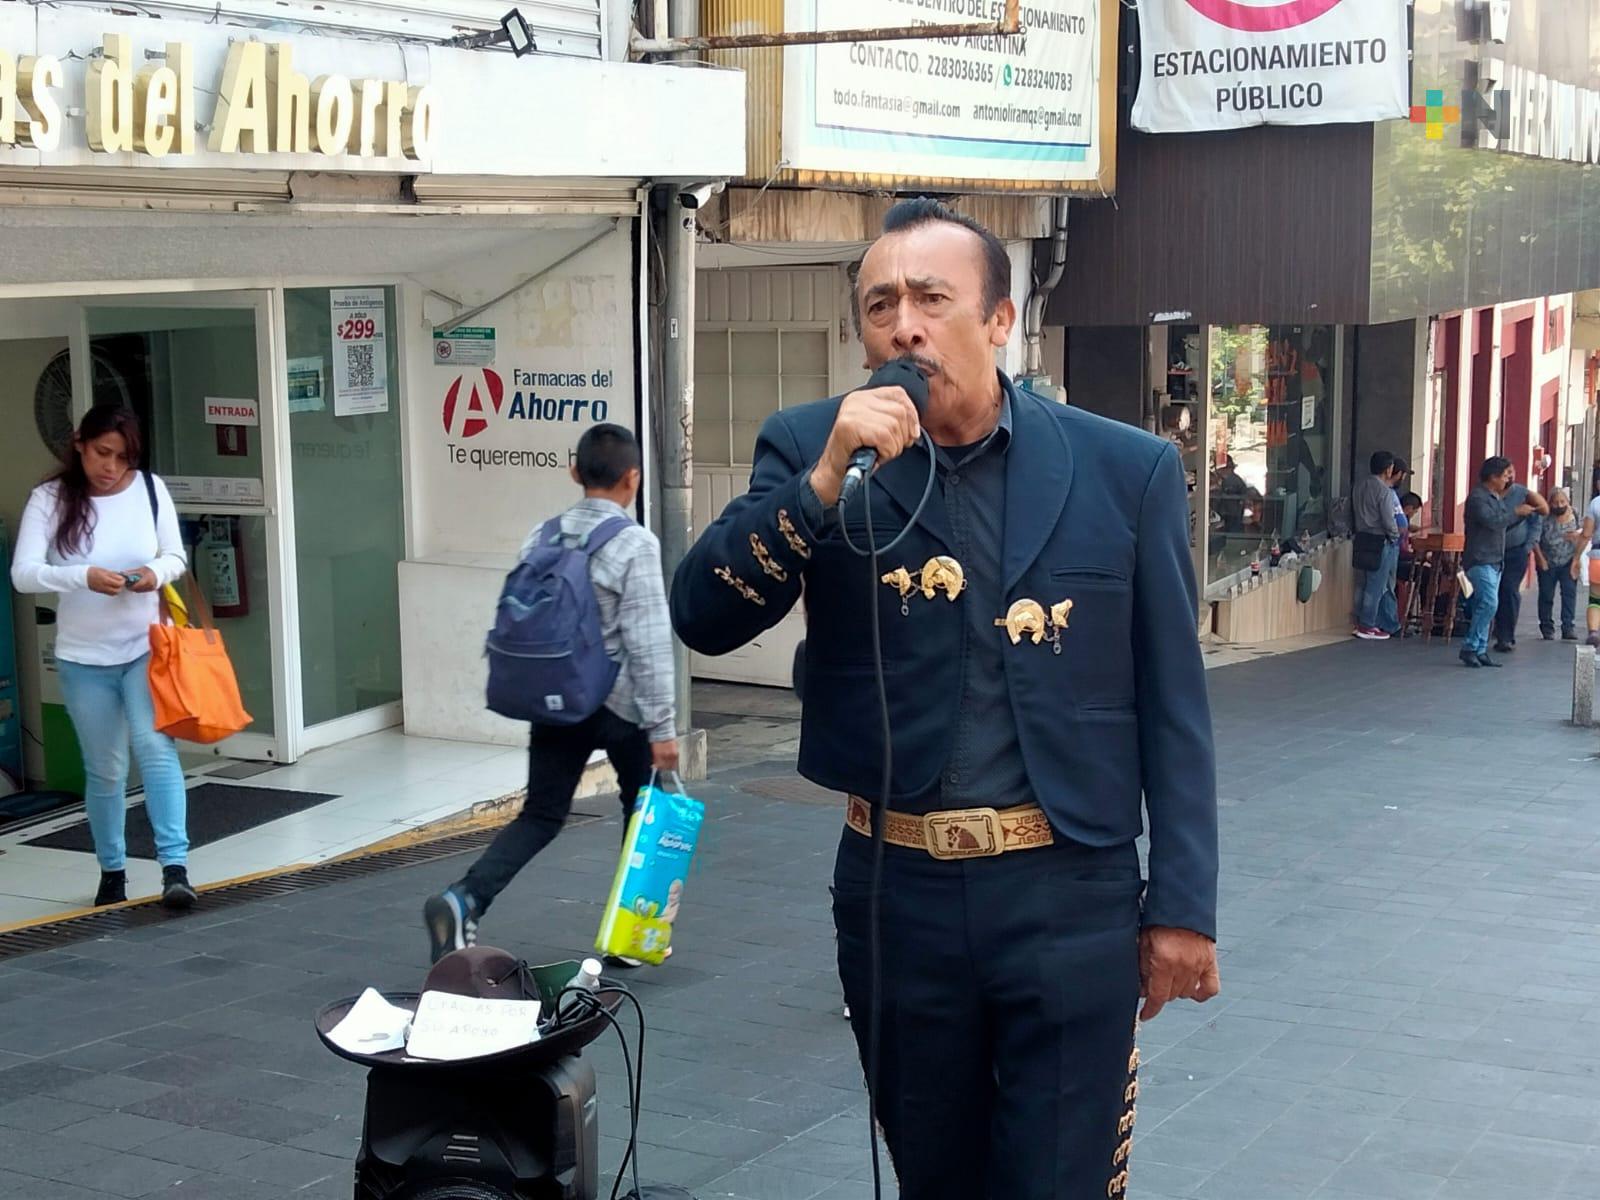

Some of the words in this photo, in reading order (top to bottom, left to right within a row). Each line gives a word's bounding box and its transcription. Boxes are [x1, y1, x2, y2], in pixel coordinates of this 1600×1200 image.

[968, 0, 988, 20] DEL
[990, 2, 1086, 35] ESTIONAMIENTO
[927, 54, 994, 84] 2283036365
[1014, 67, 1073, 92] 2283240783
[1154, 38, 1387, 78] ESTACIONAMIENTO
[87, 33, 195, 158] del
[209, 41, 436, 162] Ahorro
[833, 87, 961, 119] todo.fantasia@gmail.com
[1217, 81, 1323, 113] PÚBLICO
[337, 319, 375, 340] $299
[514, 368, 587, 388] Farmacias
[592, 369, 613, 388] del
[208, 405, 255, 418] ENTRADA
[508, 391, 608, 422] Ahorro
[448, 444, 467, 464] Te
